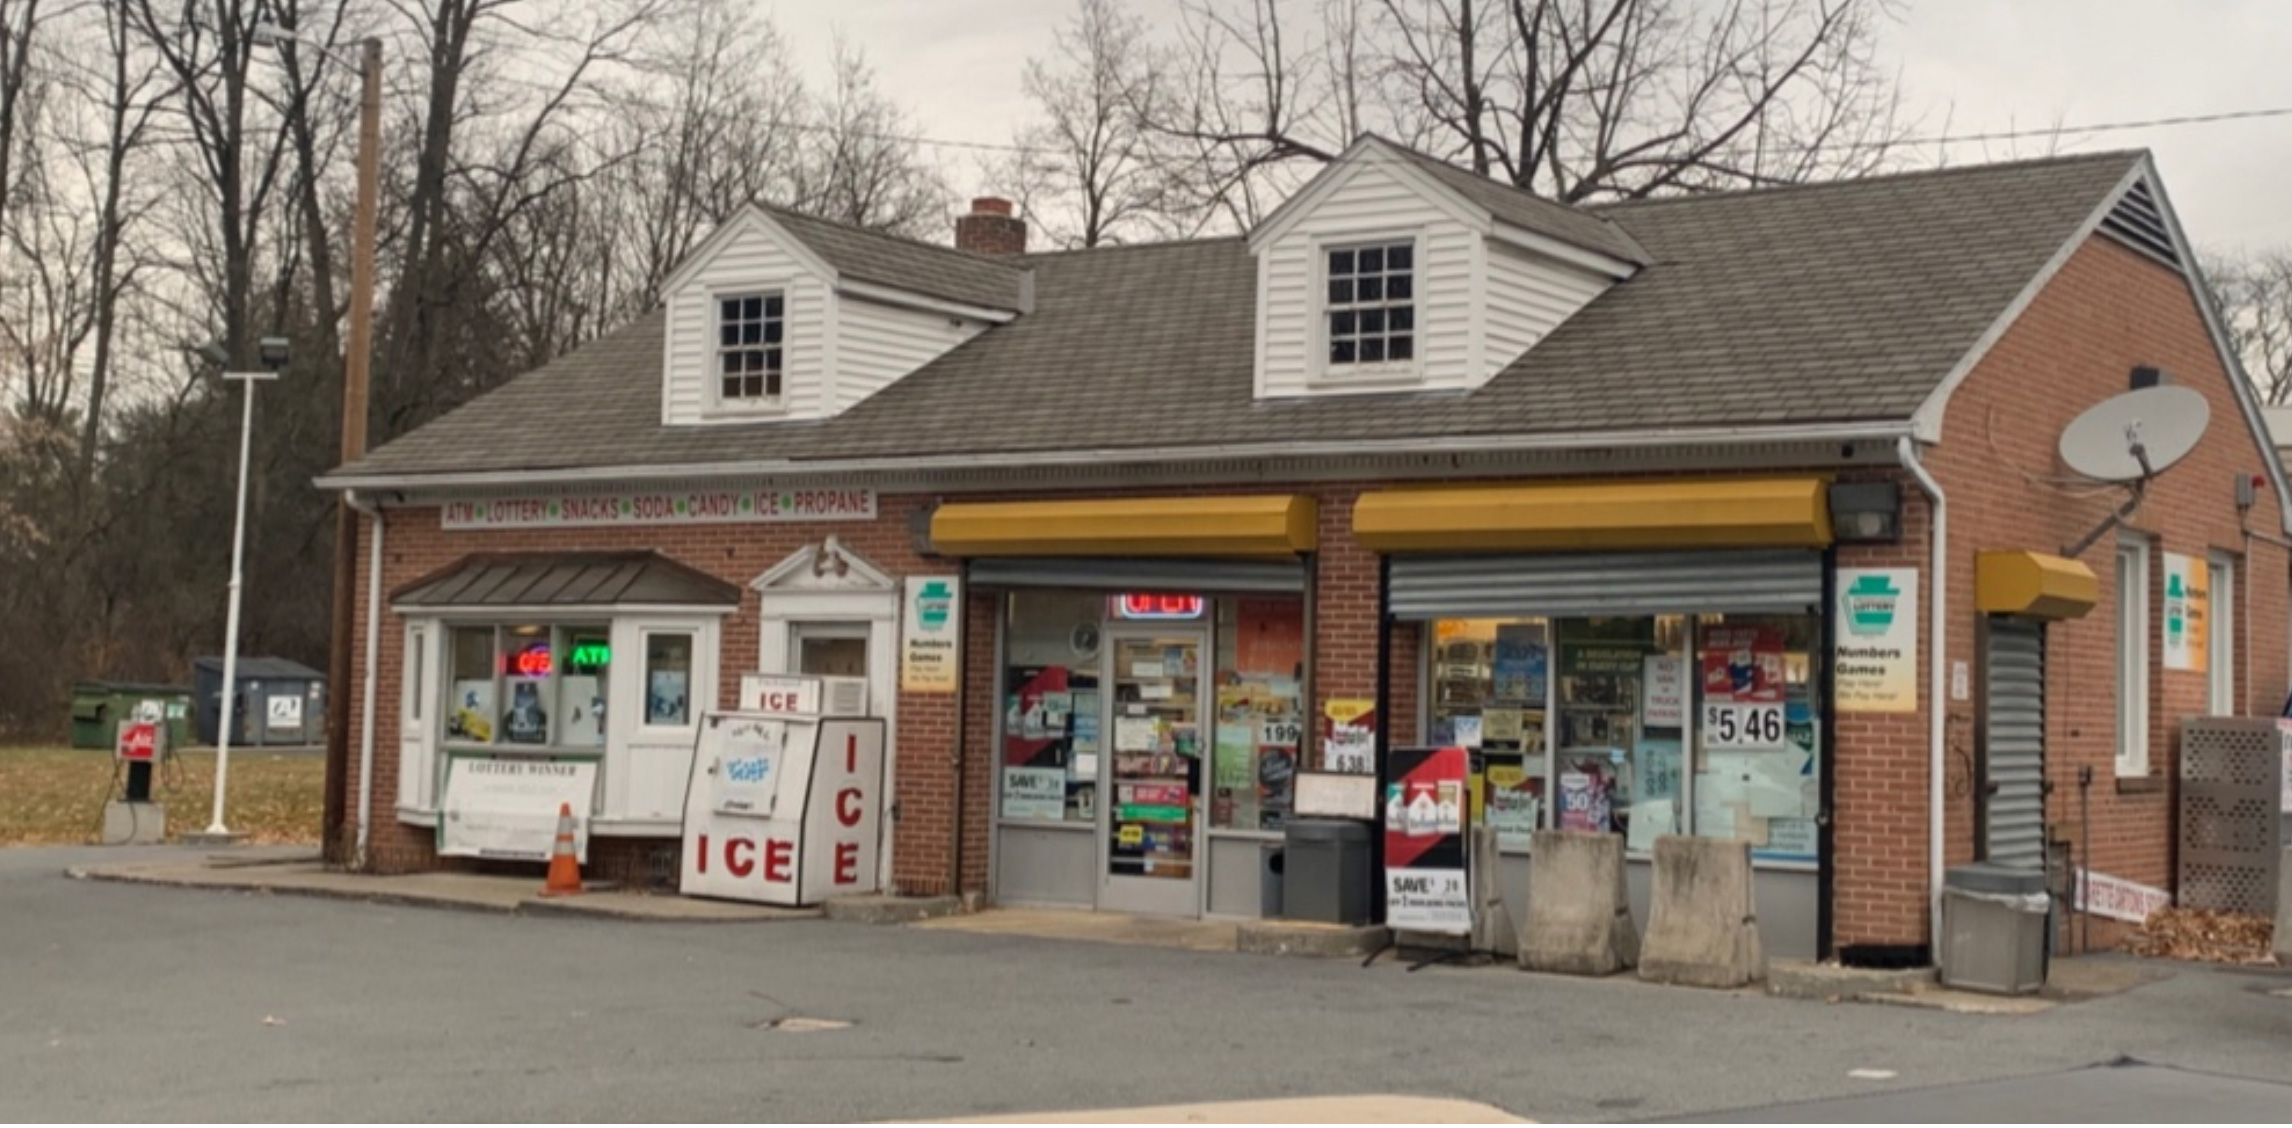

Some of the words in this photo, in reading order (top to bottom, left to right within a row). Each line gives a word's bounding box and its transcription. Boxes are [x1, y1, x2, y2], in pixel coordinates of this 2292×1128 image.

[446, 502, 474, 522] ATM
[487, 499, 547, 522] LOTTERY
[562, 497, 618, 519] SNACKS
[633, 496, 674, 518] SODA
[688, 494, 738, 517] CANDY
[754, 492, 779, 515] ICE
[794, 489, 869, 514] PROPANE
[1837, 646, 1901, 658] Numbers
[1837, 663, 1885, 675] Games
[761, 692, 798, 710] ICE
[469, 762, 523, 775] LOTTERY
[529, 764, 577, 776] WINNER
[1008, 774, 1038, 788] SAVE
[833, 734, 863, 884] ICE
[697, 833, 794, 883] ICE
[1393, 877, 1429, 893] SAVE
